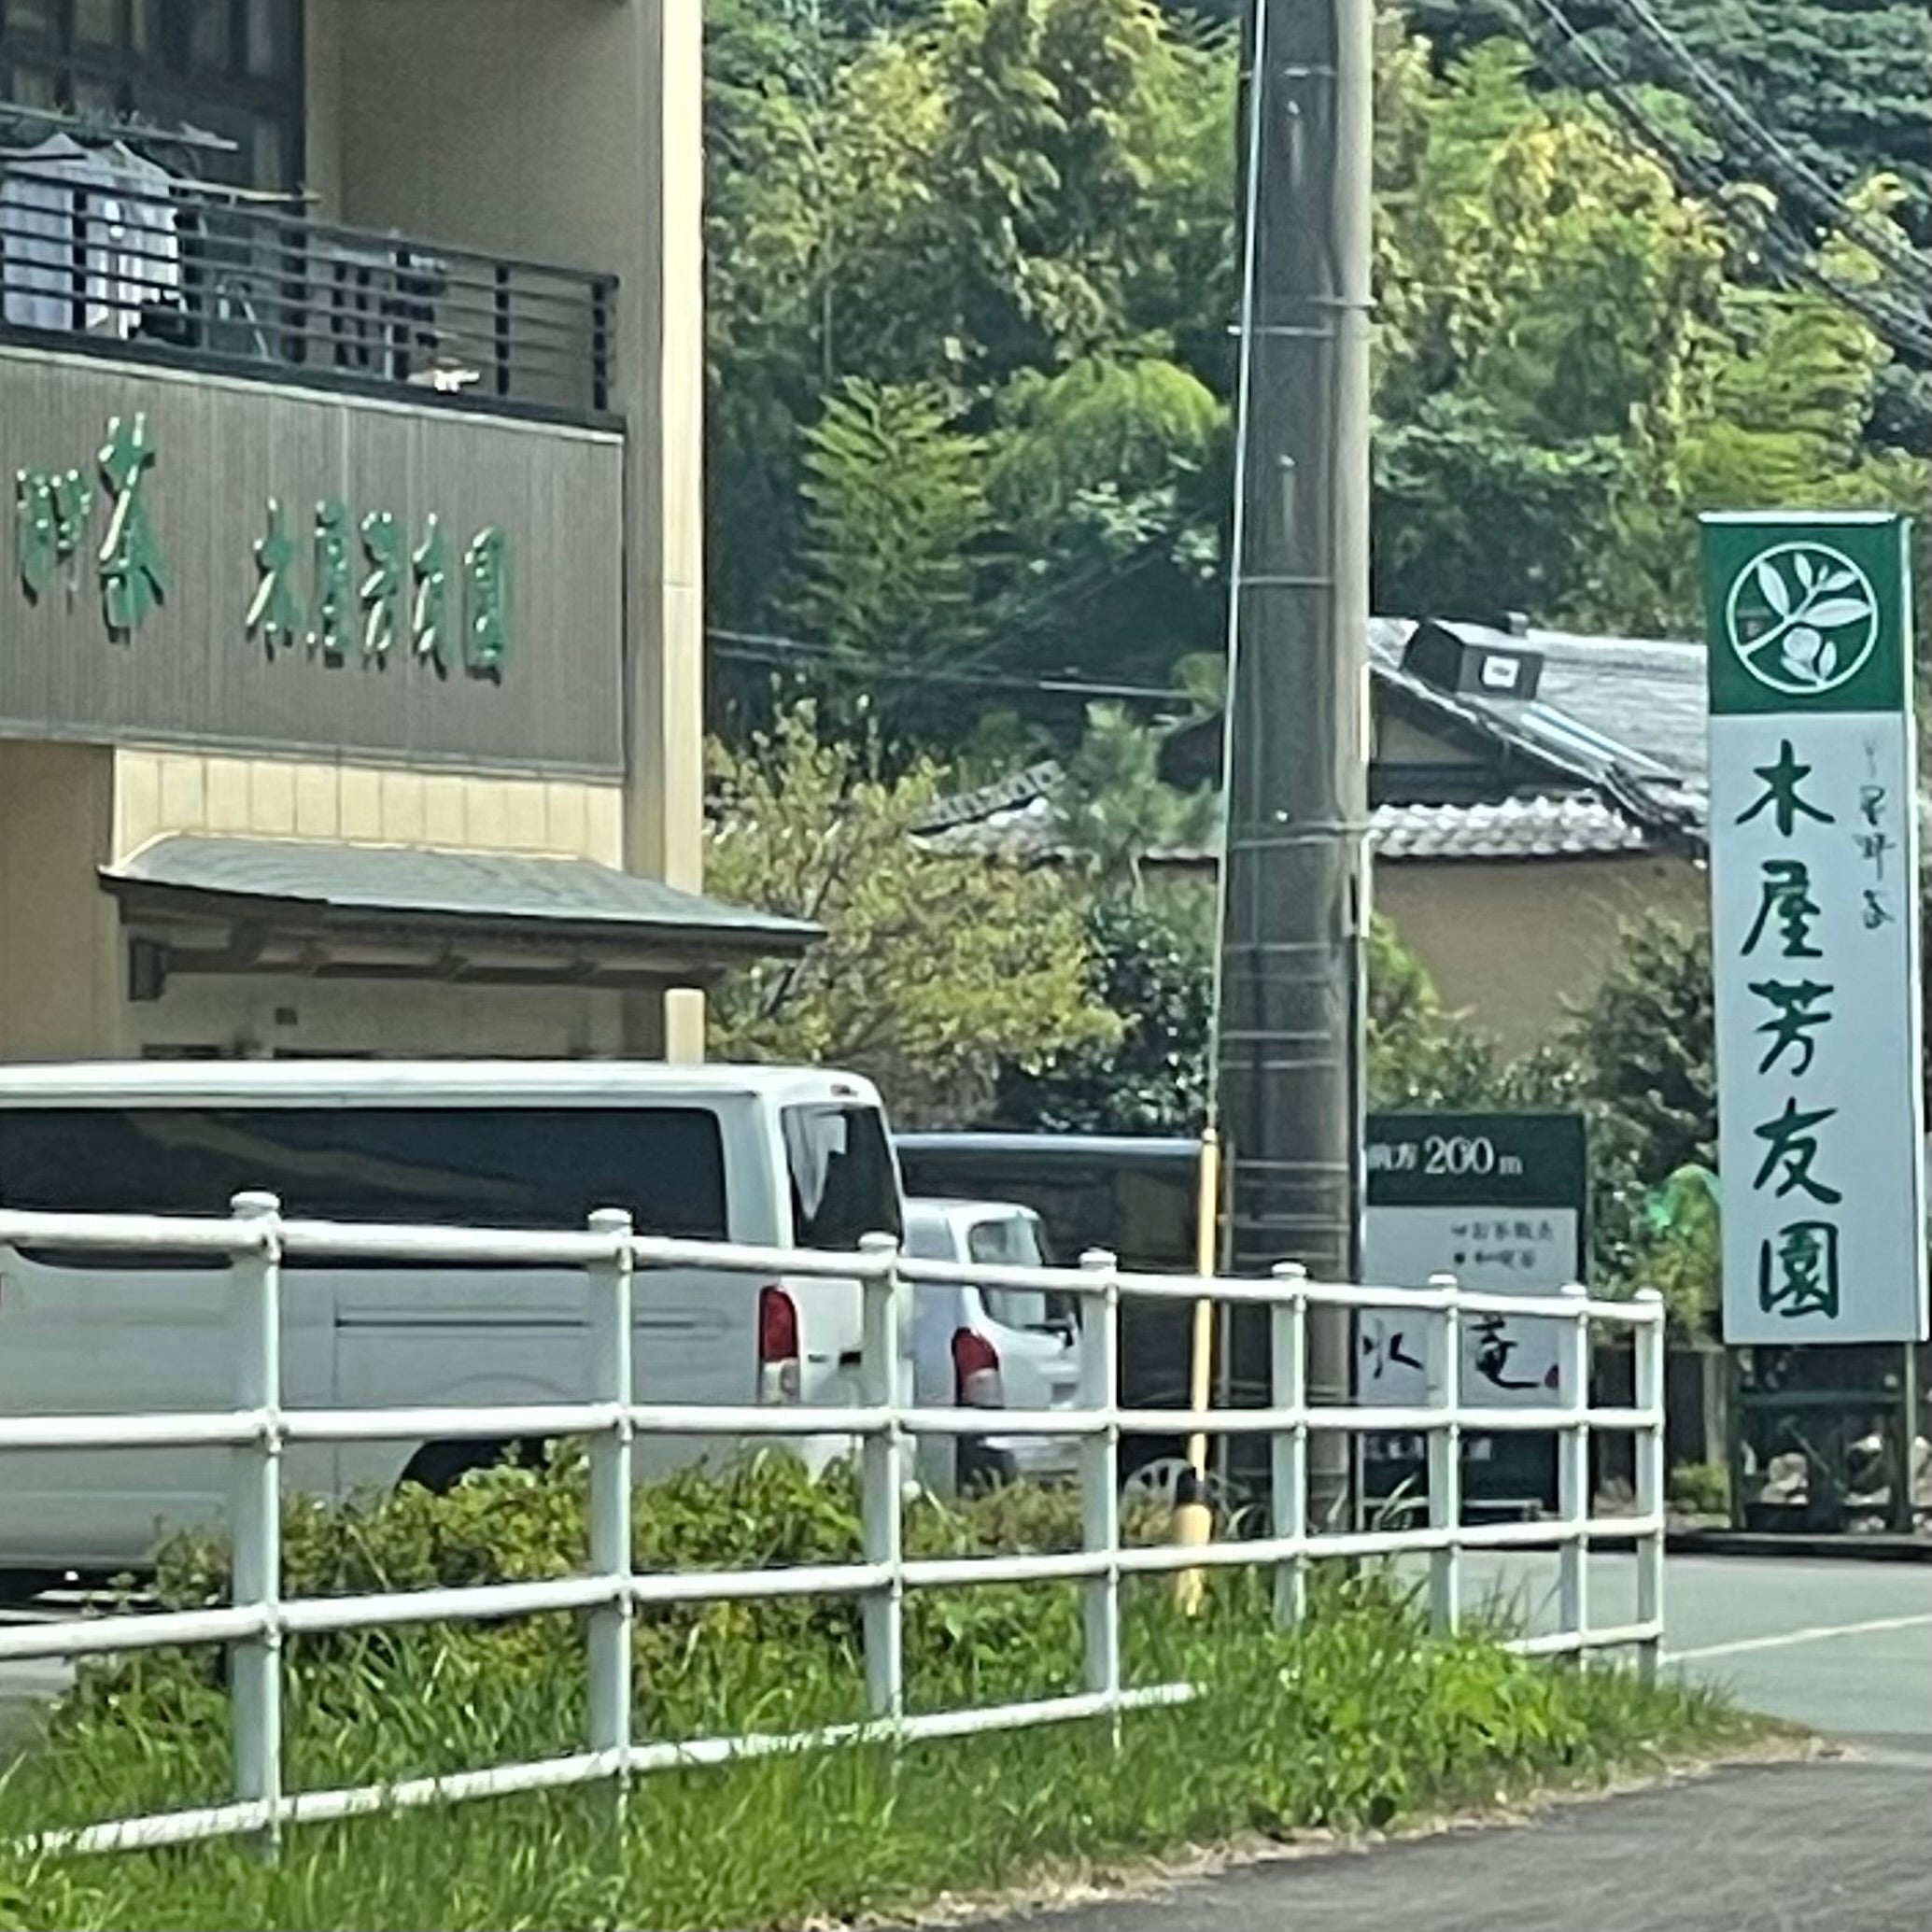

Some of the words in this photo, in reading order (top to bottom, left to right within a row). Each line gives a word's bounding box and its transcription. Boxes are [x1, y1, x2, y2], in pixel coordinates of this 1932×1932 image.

[1735, 739, 1843, 1319] 木屋芳友園
